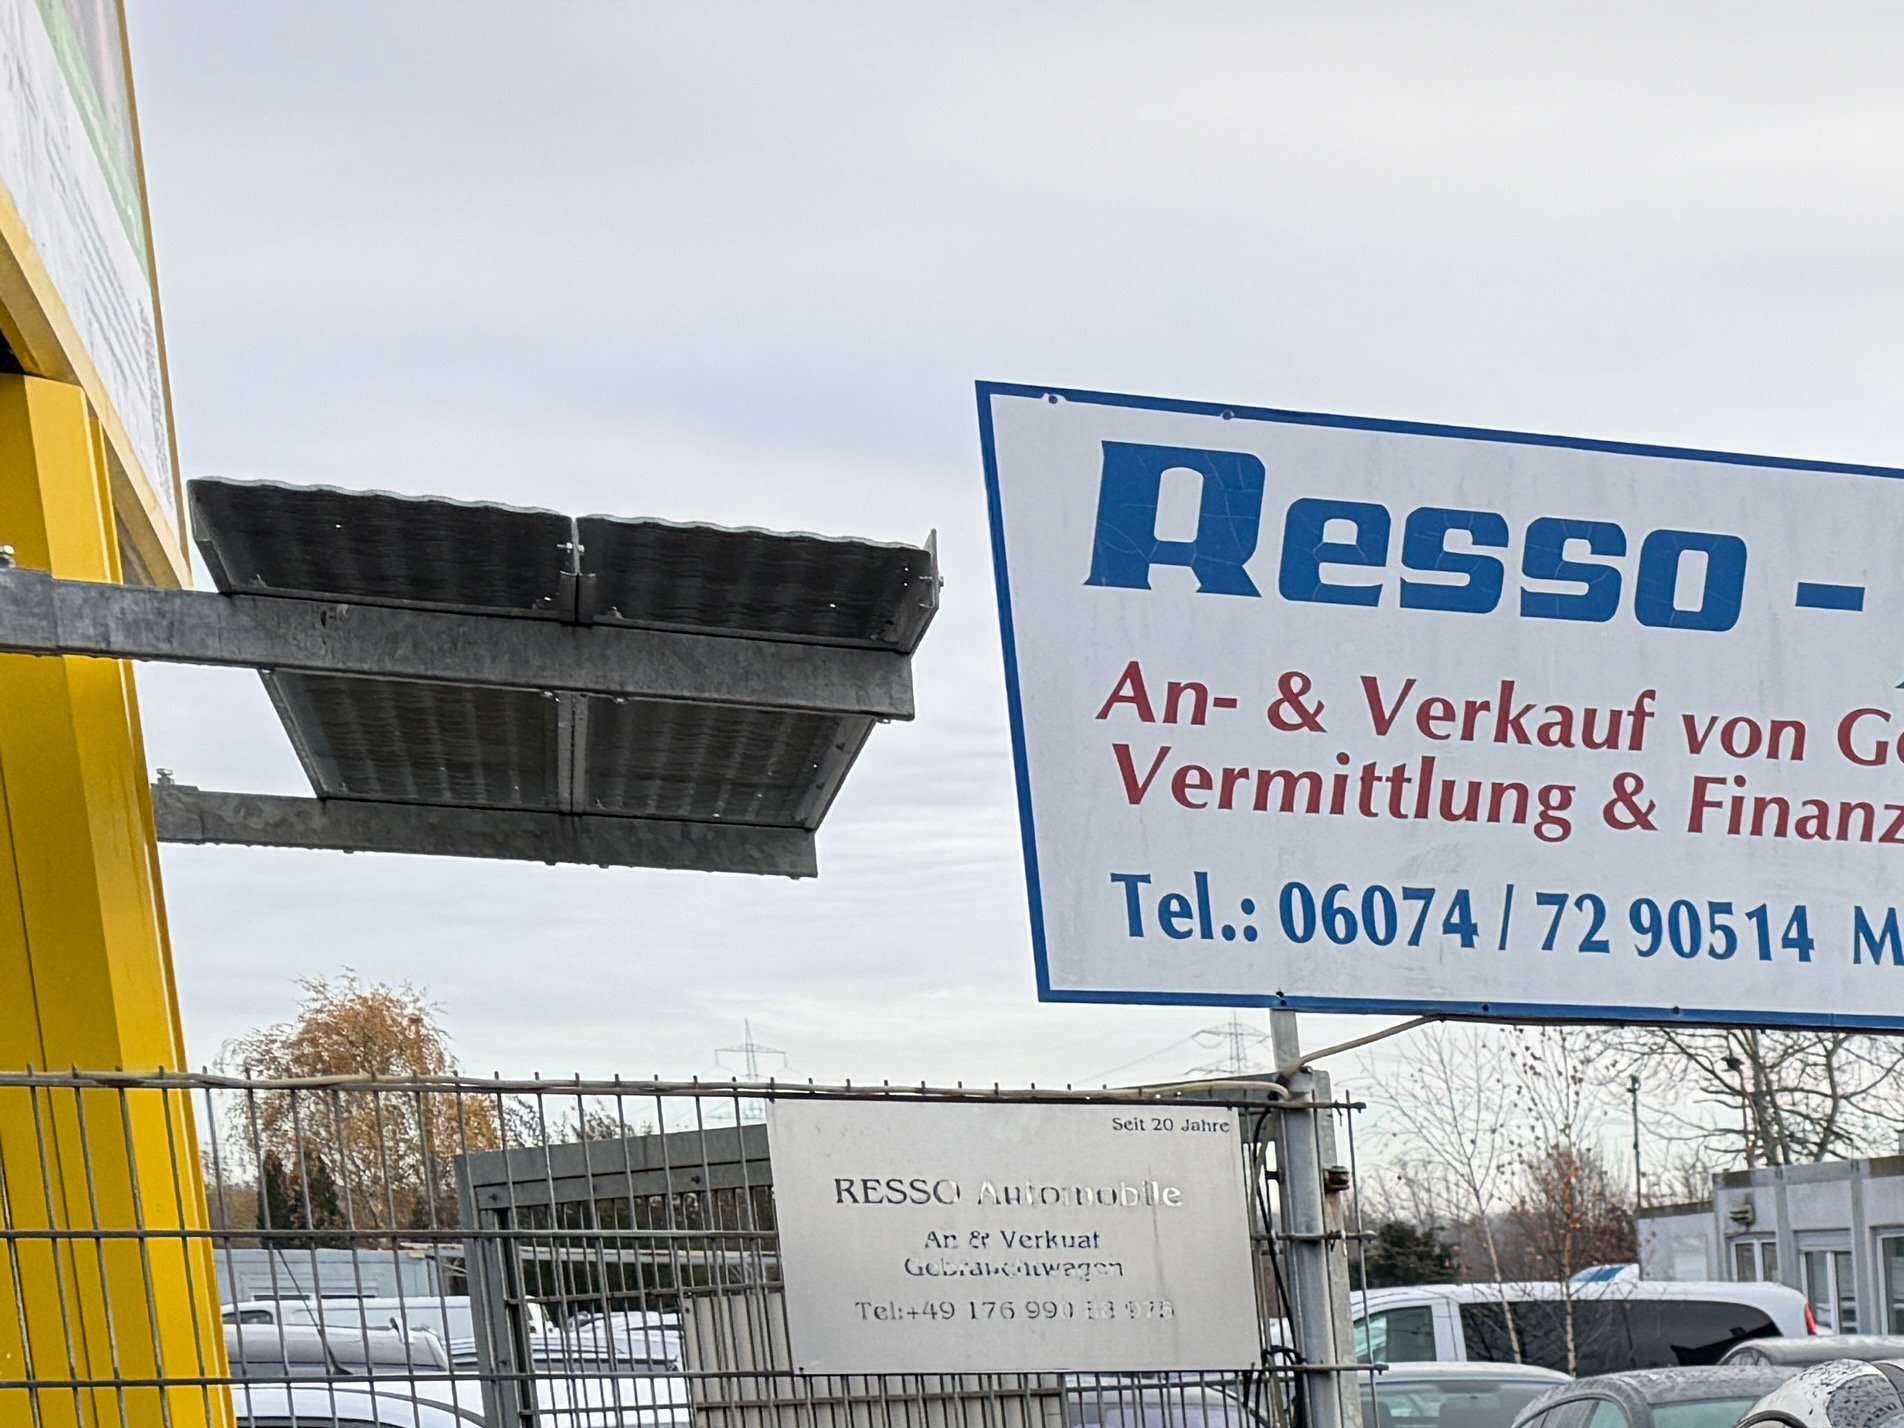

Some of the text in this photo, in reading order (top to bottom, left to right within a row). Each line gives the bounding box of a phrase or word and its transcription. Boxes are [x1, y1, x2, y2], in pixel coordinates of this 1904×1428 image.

[1083, 440, 1747, 632] Resso
[1794, 580, 1865, 613] -
[1096, 661, 1237, 727] An-
[1267, 671, 1327, 733] &
[1360, 675, 1657, 752] Verkauf
[1681, 714, 1807, 762] von
[1112, 743, 1577, 843] Vermittlung
[1601, 772, 1658, 832] &
[1110, 872, 1259, 943] Tel.:
[1279, 881, 1479, 949] 06074
[1535, 891, 1612, 954] 72
[1629, 898, 1815, 963] 90514
[1111, 1117, 1231, 1134] Seit 20 Jahre
[834, 1178, 961, 1206] RESSO
[969, 1300, 1016, 1321] 176
